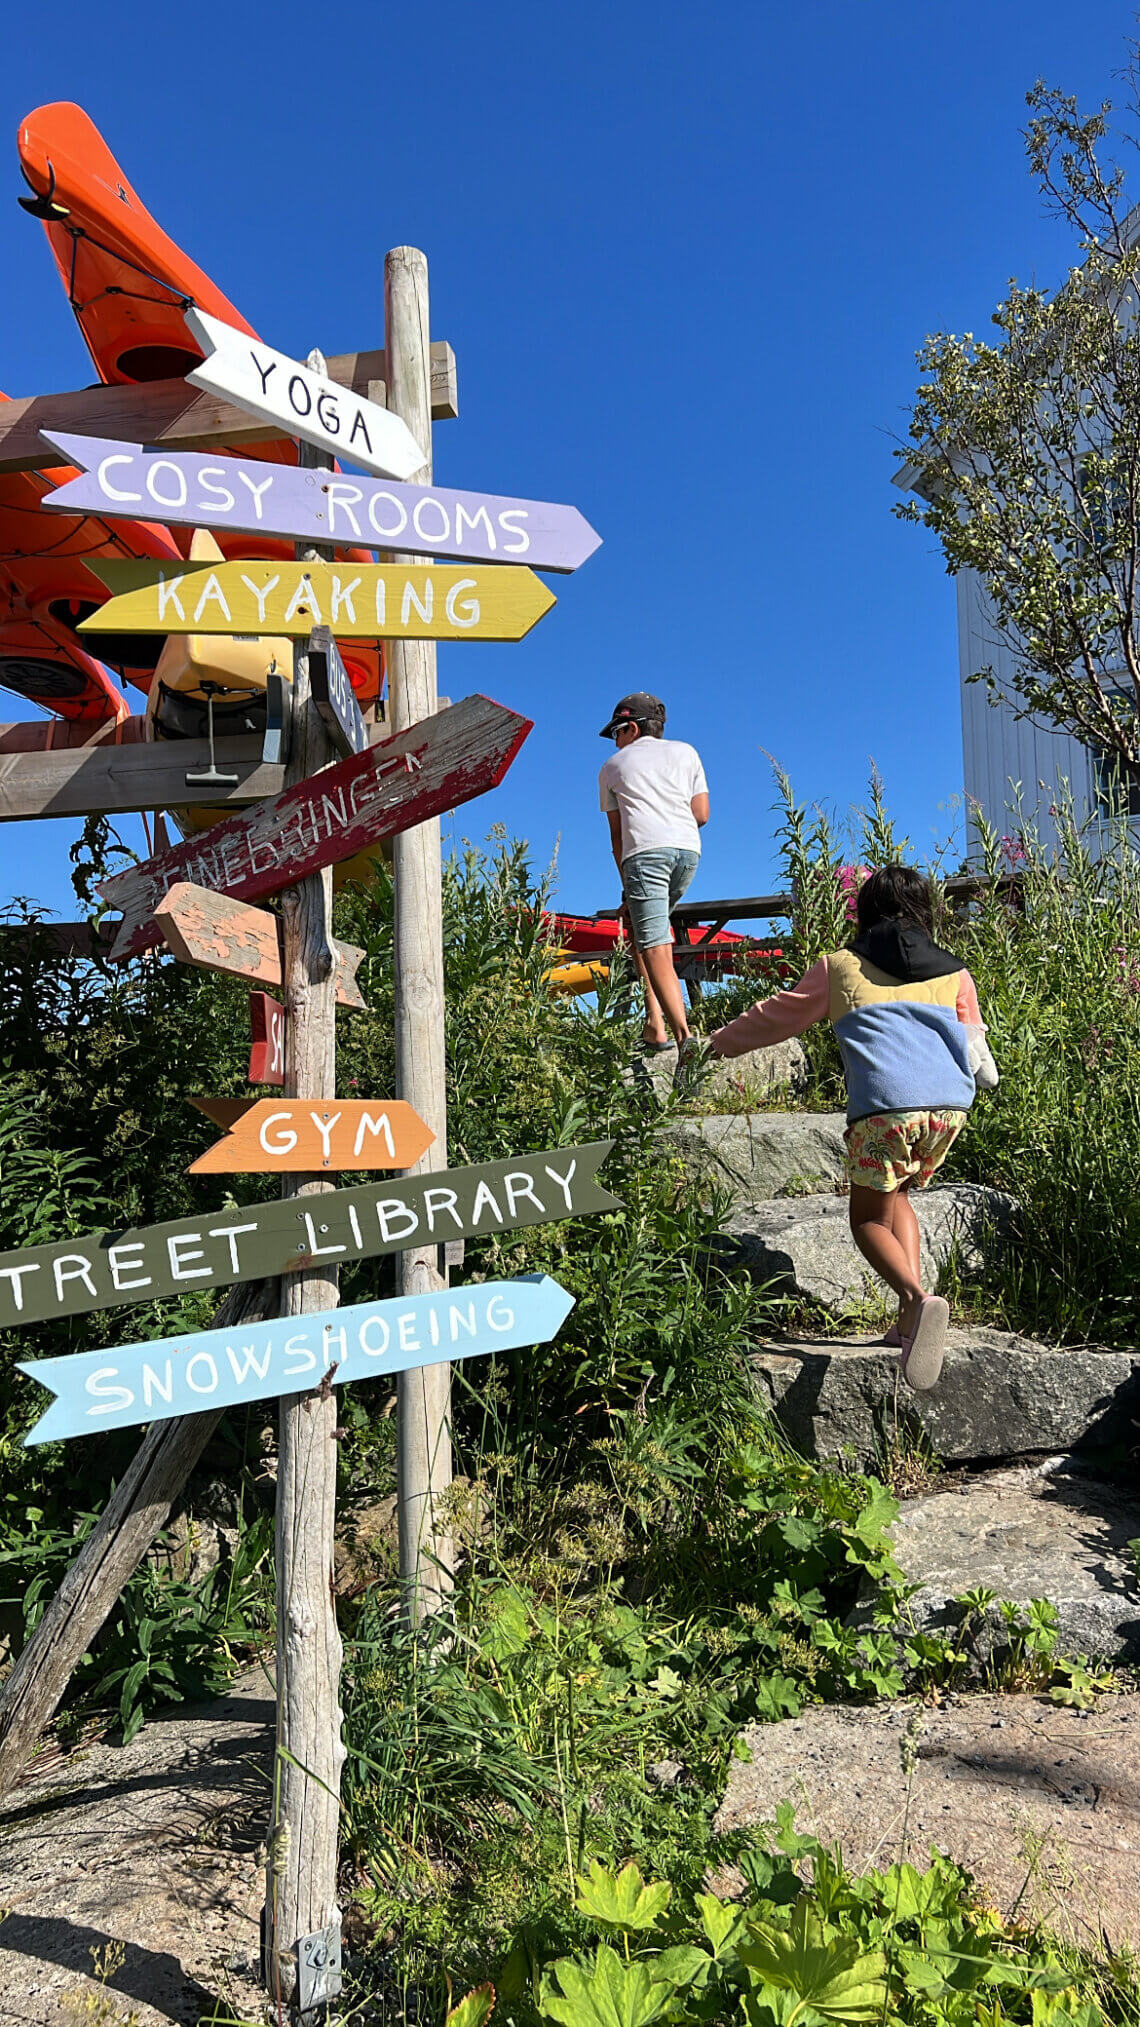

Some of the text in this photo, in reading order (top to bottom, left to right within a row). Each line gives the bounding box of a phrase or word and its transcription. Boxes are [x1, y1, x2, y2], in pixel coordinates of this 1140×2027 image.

[250, 351, 373, 454] YOGA
[97, 454, 530, 554] COSY ROOMS
[158, 571, 481, 629] KAYAKING
[259, 1111, 396, 1158] GYM
[304, 1159, 577, 1256] LIBRARY
[85, 1294, 515, 1416] SNOWSHOEING
